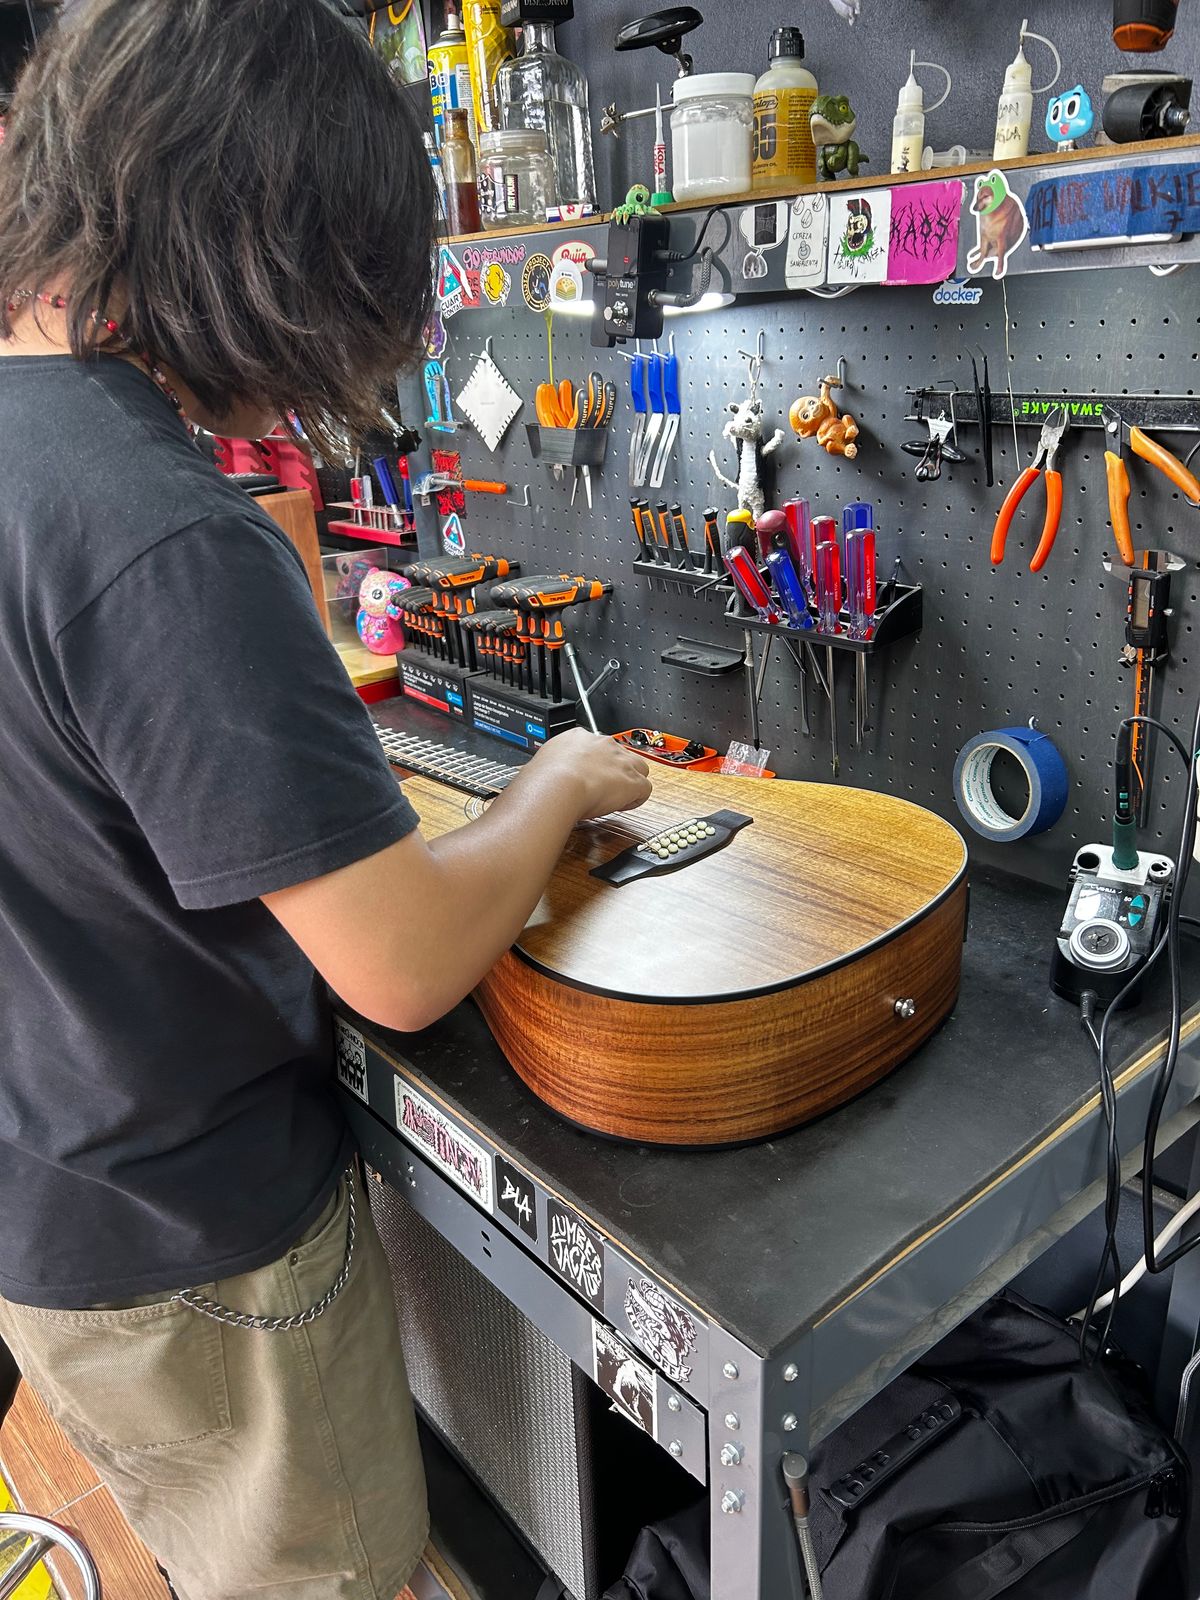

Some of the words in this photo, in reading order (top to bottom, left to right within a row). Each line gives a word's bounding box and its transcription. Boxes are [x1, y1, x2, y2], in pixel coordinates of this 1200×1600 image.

[889, 198, 958, 263] KAOS
[440, 292, 462, 311] CUART
[935, 288, 980, 302] docker
[501, 1175, 532, 1222] BLA
[550, 1213, 602, 1287] LUMBER
